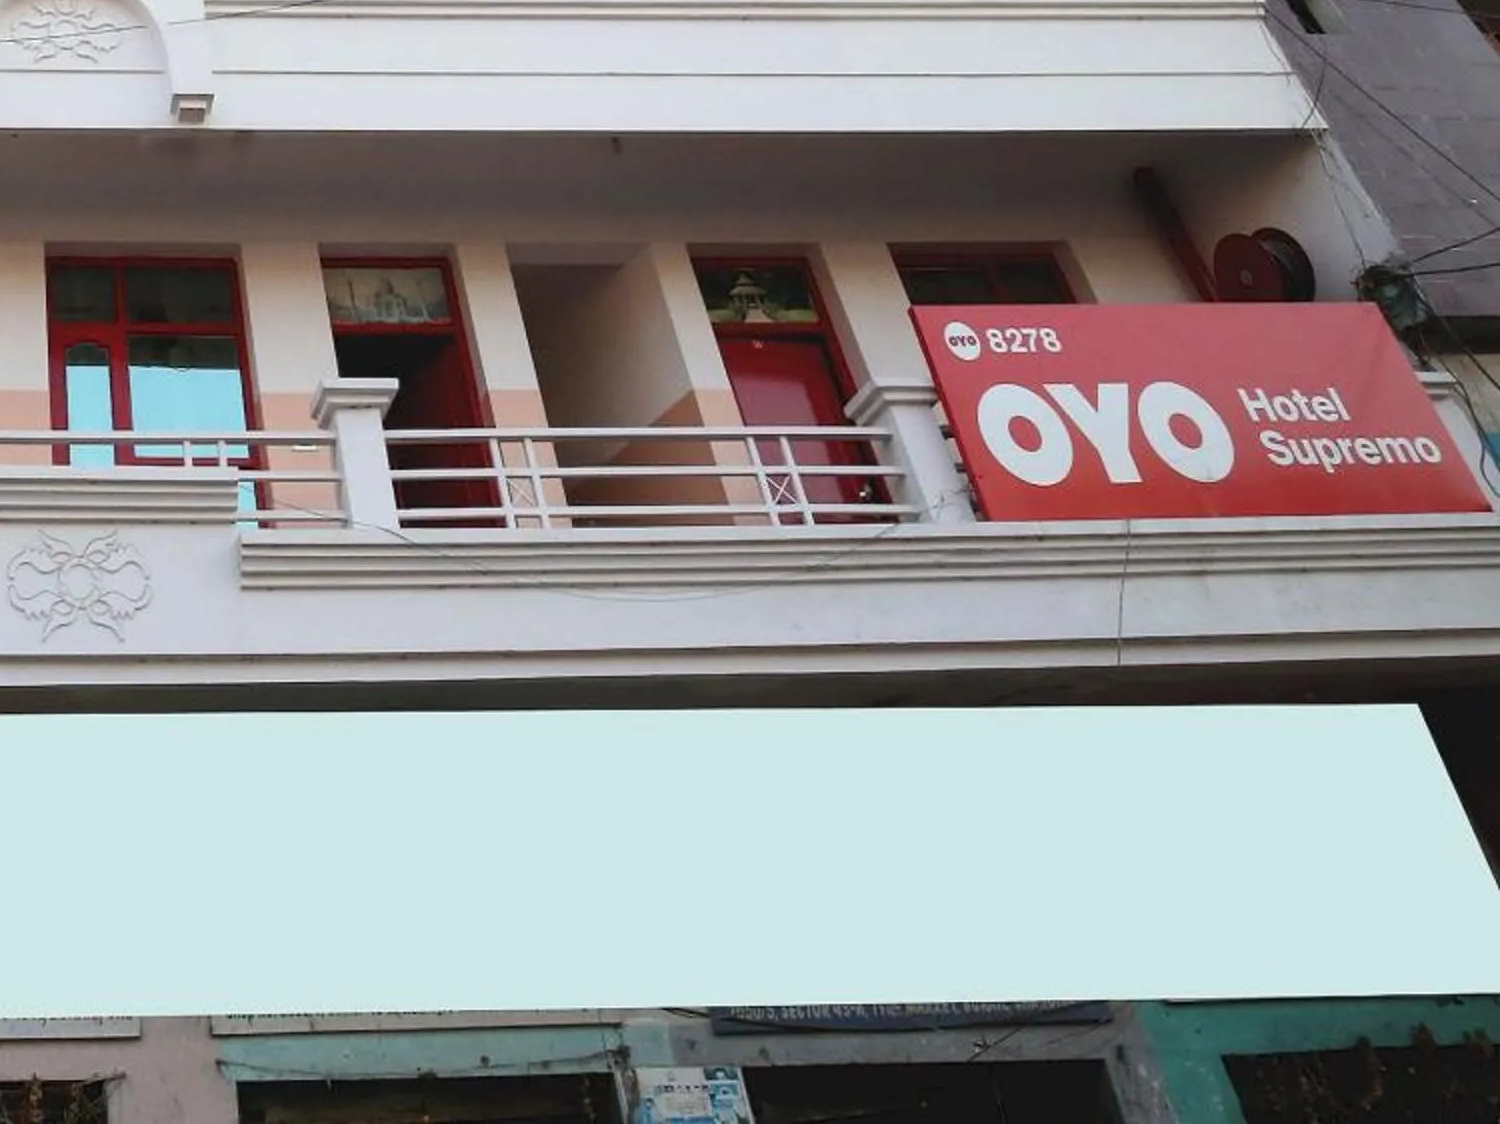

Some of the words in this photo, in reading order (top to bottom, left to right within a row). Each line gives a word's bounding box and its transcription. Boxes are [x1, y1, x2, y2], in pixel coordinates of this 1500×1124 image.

[949, 335, 977, 347] OYO
[985, 327, 1062, 353] 8278
[1237, 387, 1351, 422] Hotel
[977, 381, 1235, 487] OYO
[1259, 429, 1442, 473] Supremo
